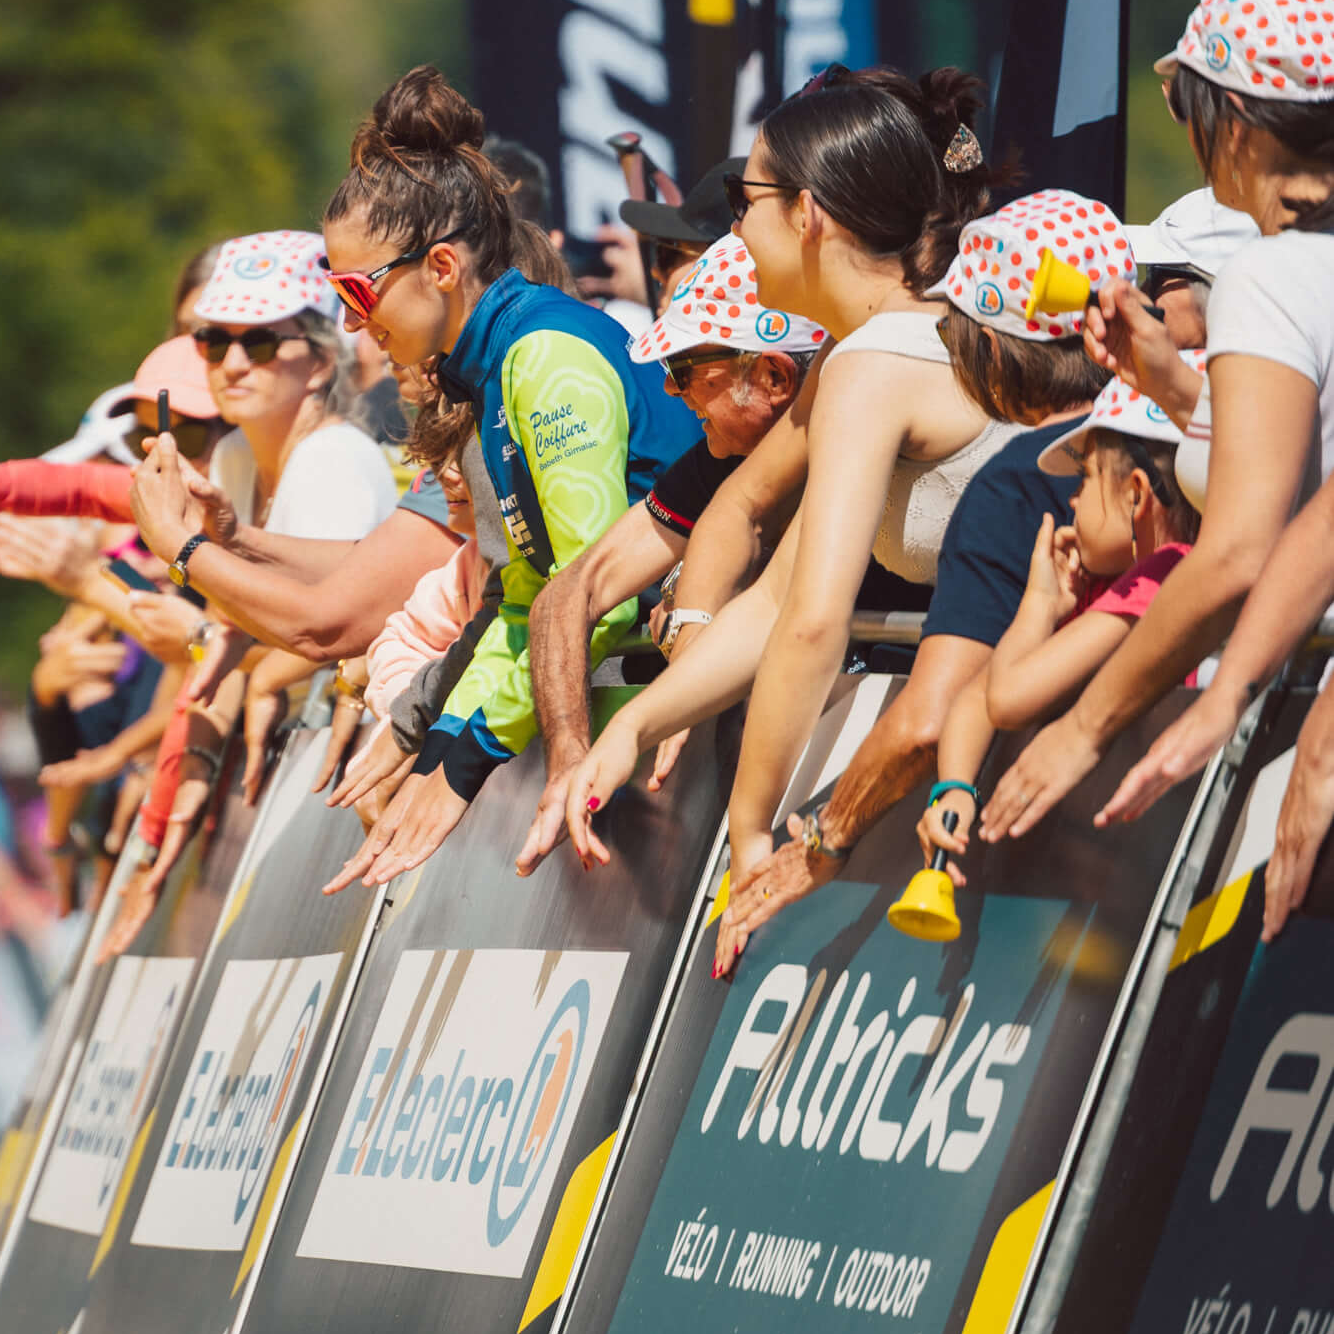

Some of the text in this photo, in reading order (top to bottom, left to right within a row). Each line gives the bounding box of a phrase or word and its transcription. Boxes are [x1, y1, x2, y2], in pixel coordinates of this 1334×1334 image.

[530, 404, 573, 434] Pause
[535, 420, 588, 458] Coiffure
[334, 1047, 514, 1186] E.Leclerc
[701, 963, 1031, 1173] Alltricks
[1210, 1013, 1334, 1213] Al
[664, 1207, 720, 1282] VÉLO
[729, 1230, 822, 1300] RUNNING
[833, 1247, 932, 1319] OUTDOOR
